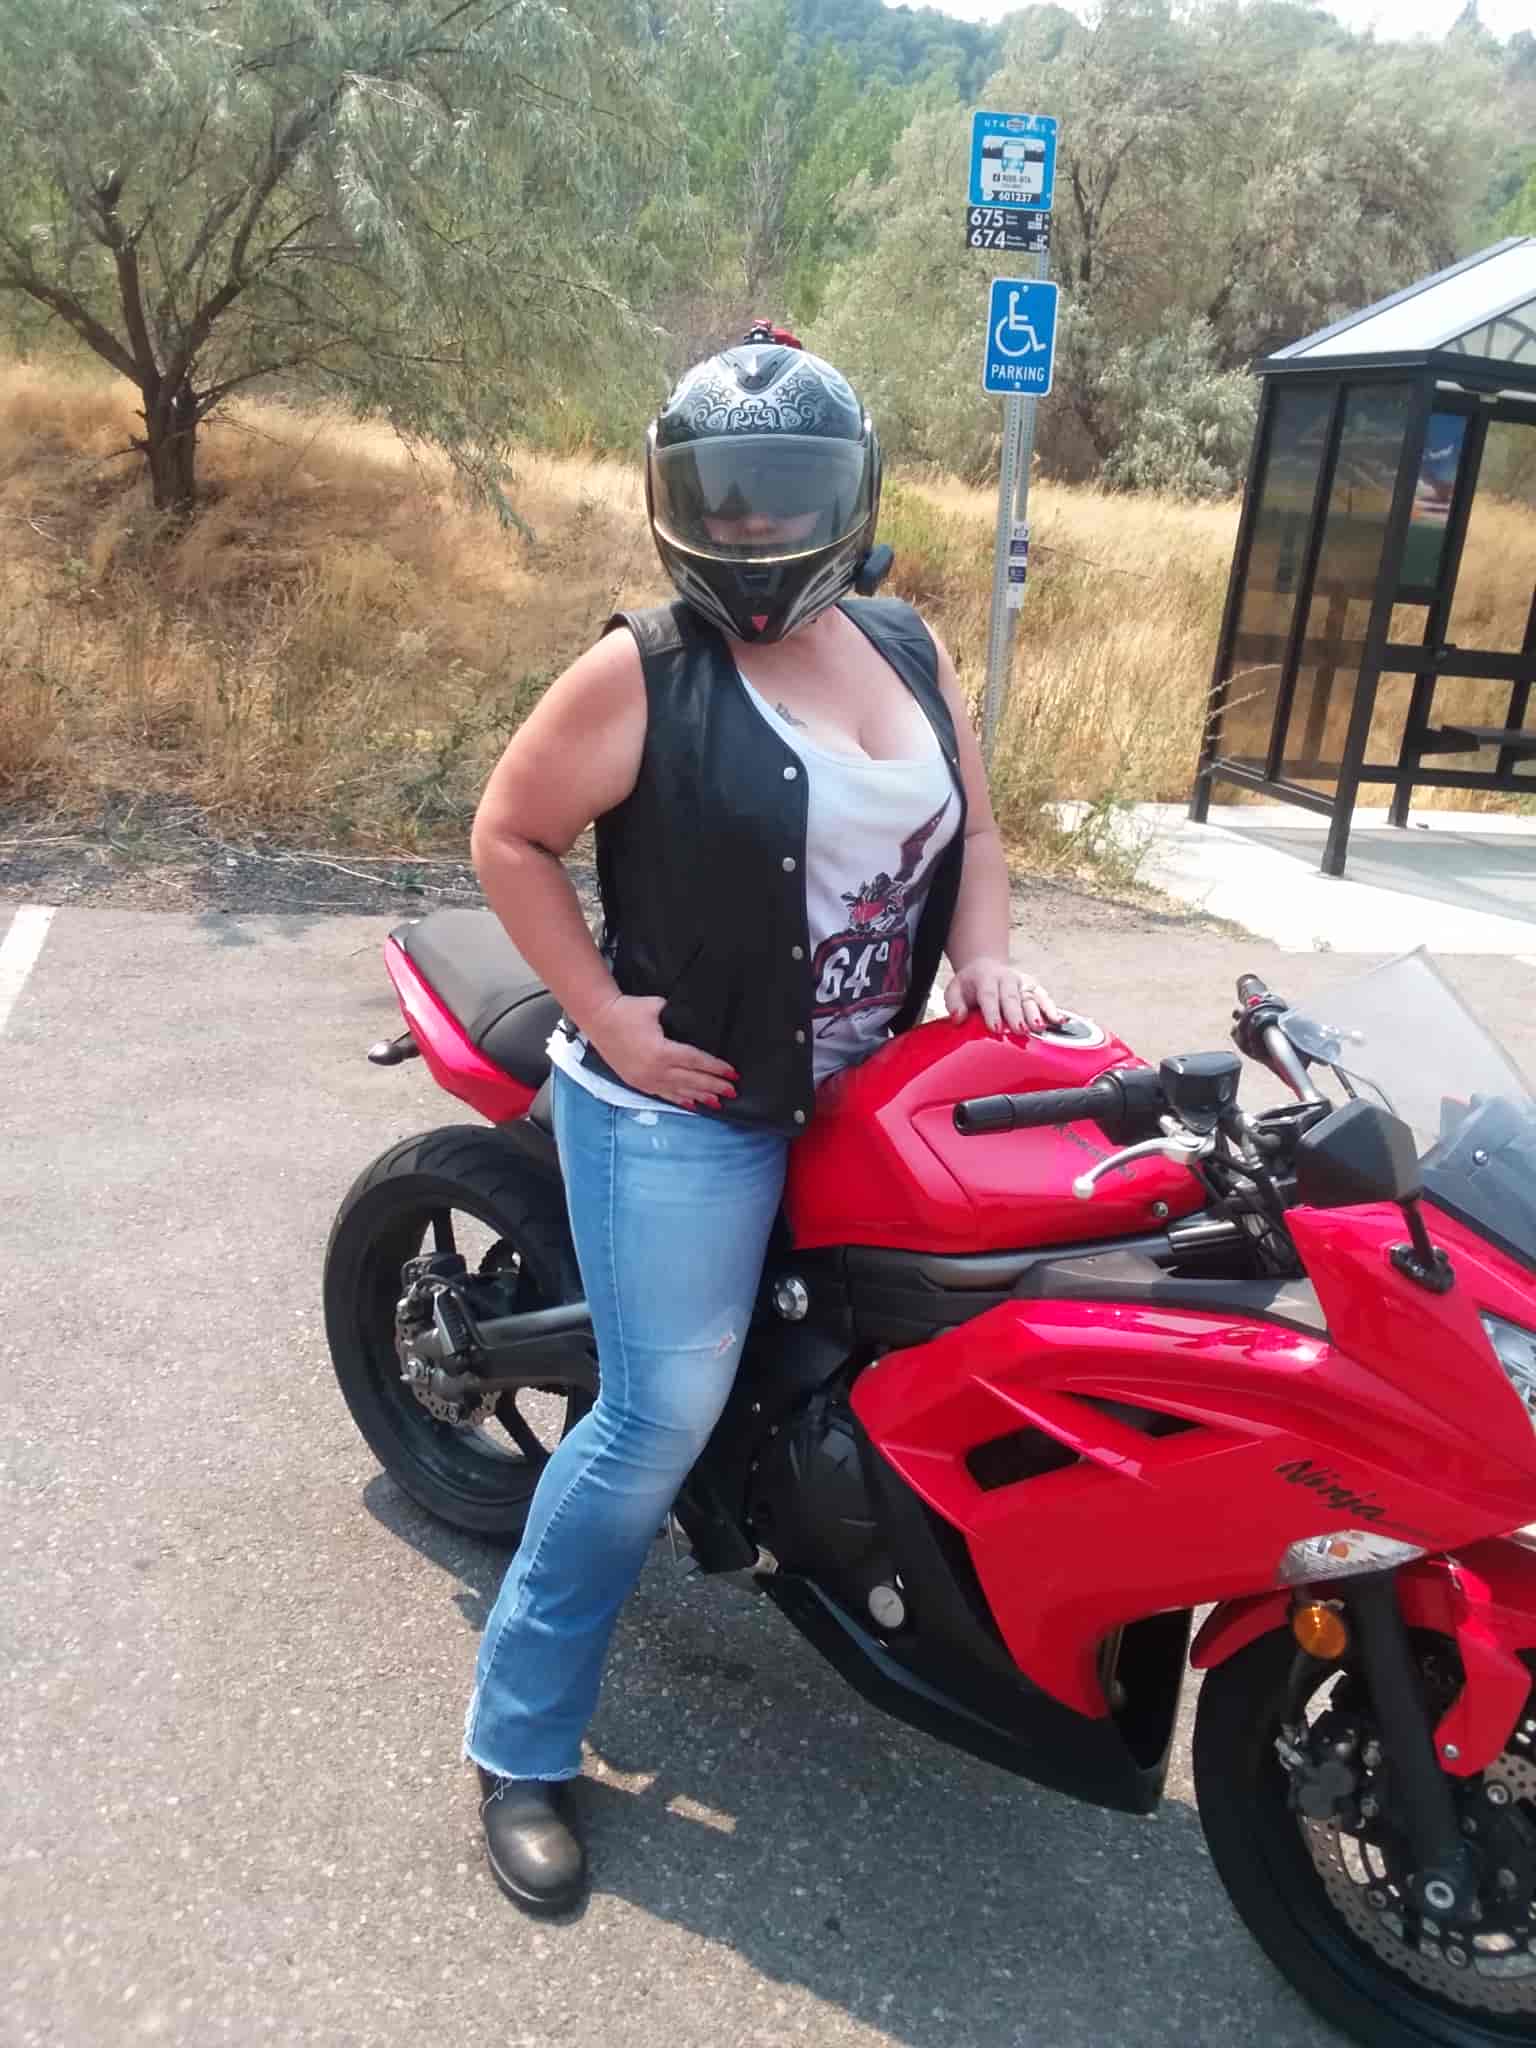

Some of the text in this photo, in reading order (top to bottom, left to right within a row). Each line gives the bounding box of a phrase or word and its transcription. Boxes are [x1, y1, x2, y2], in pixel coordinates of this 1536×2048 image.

[970, 208, 1004, 228] 675
[970, 229, 1006, 249] 674
[991, 363, 1045, 382] PARKING
[1273, 1459, 1387, 1520] Ninja
